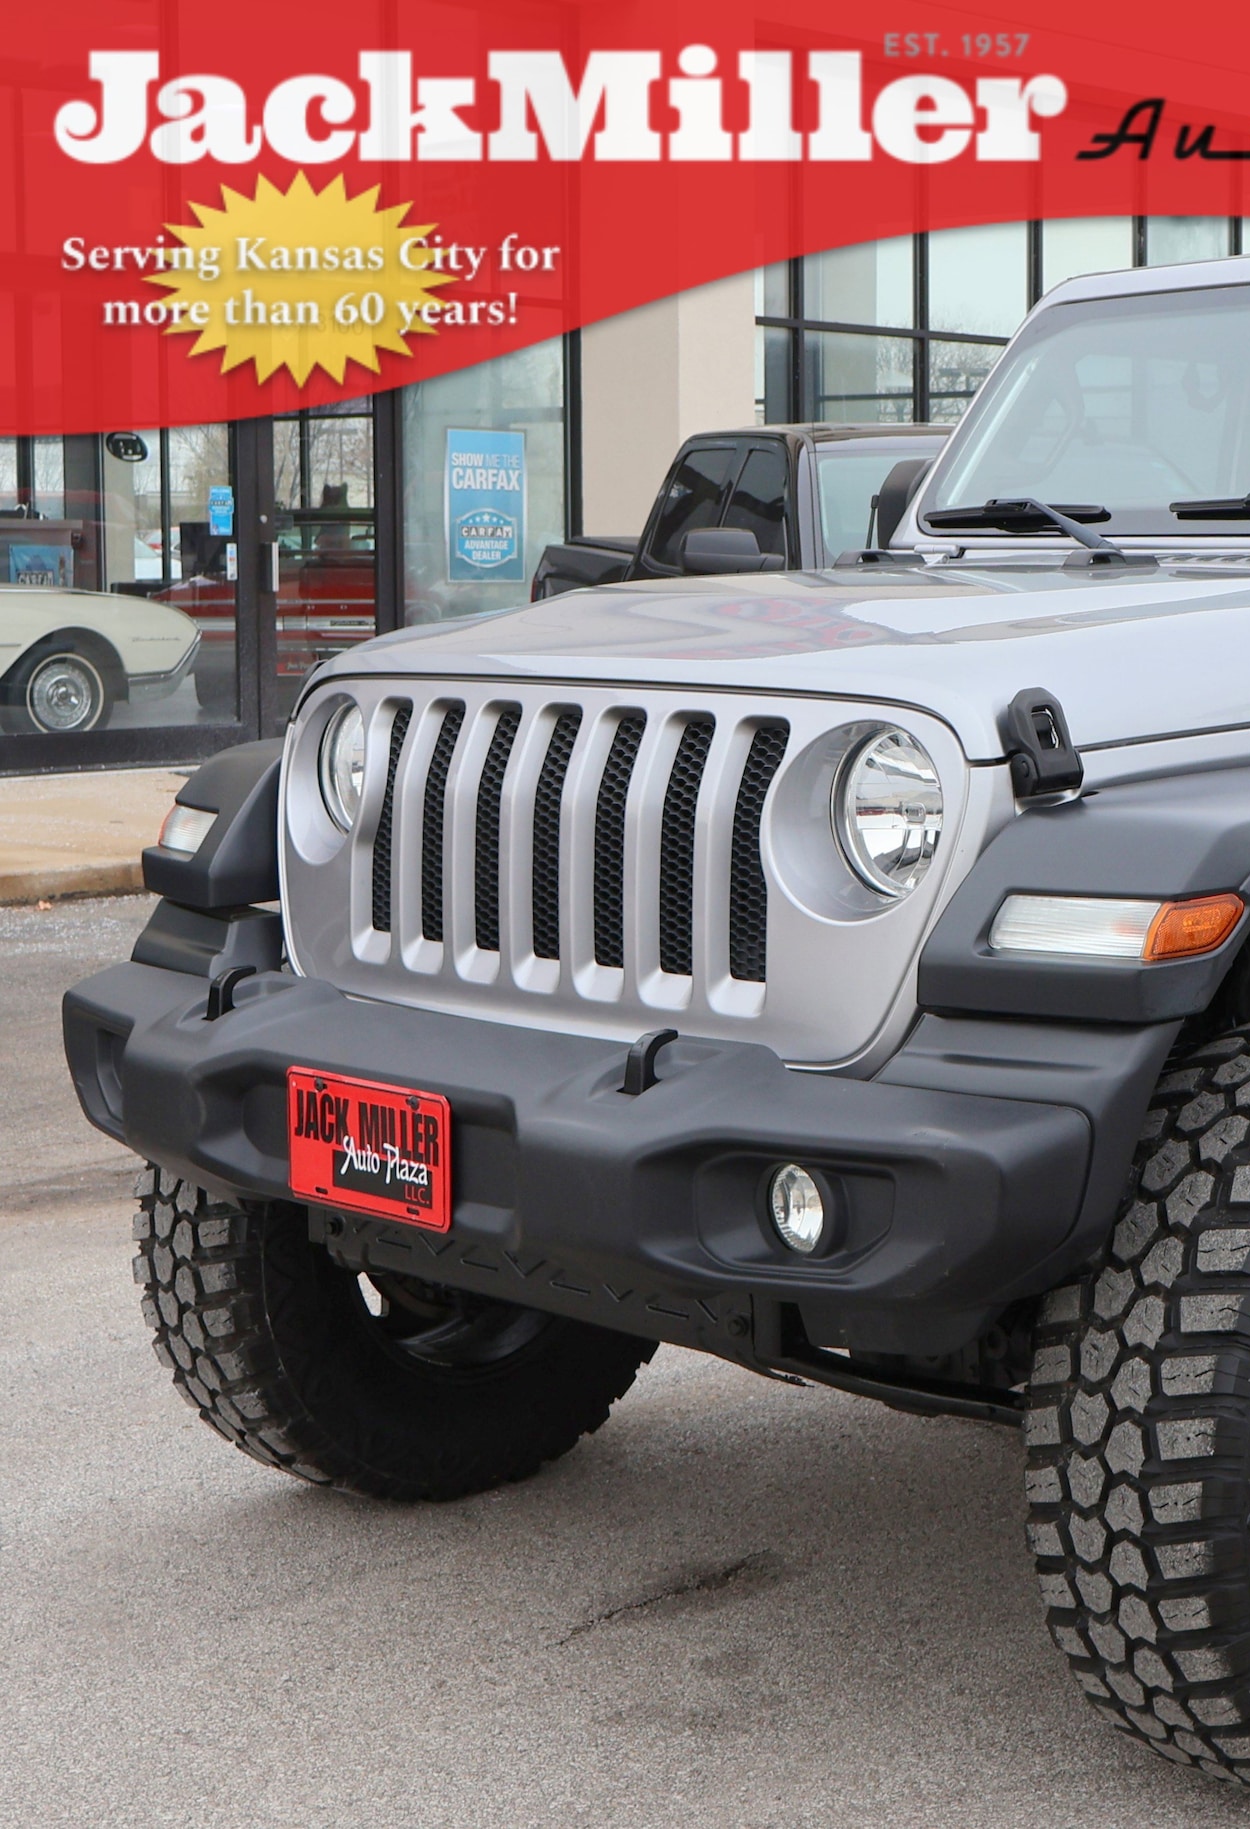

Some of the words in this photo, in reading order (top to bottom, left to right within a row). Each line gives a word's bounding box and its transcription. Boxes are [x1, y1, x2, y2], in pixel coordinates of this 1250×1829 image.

[451, 452, 484, 467] SHOW
[486, 454, 501, 468] ME
[502, 455, 520, 469] THE
[452, 468, 521, 491] CARFAX
[461, 526, 513, 538] CARFAX
[464, 540, 509, 551] ADVANTAGE
[472, 550, 502, 561] DEALER
[294, 1088, 350, 1147] JACK
[358, 1101, 439, 1168] MILLER
[340, 1135, 381, 1176] Auto
[383, 1142, 429, 1186] Plaza
[405, 1185, 430, 1206] LLC.
